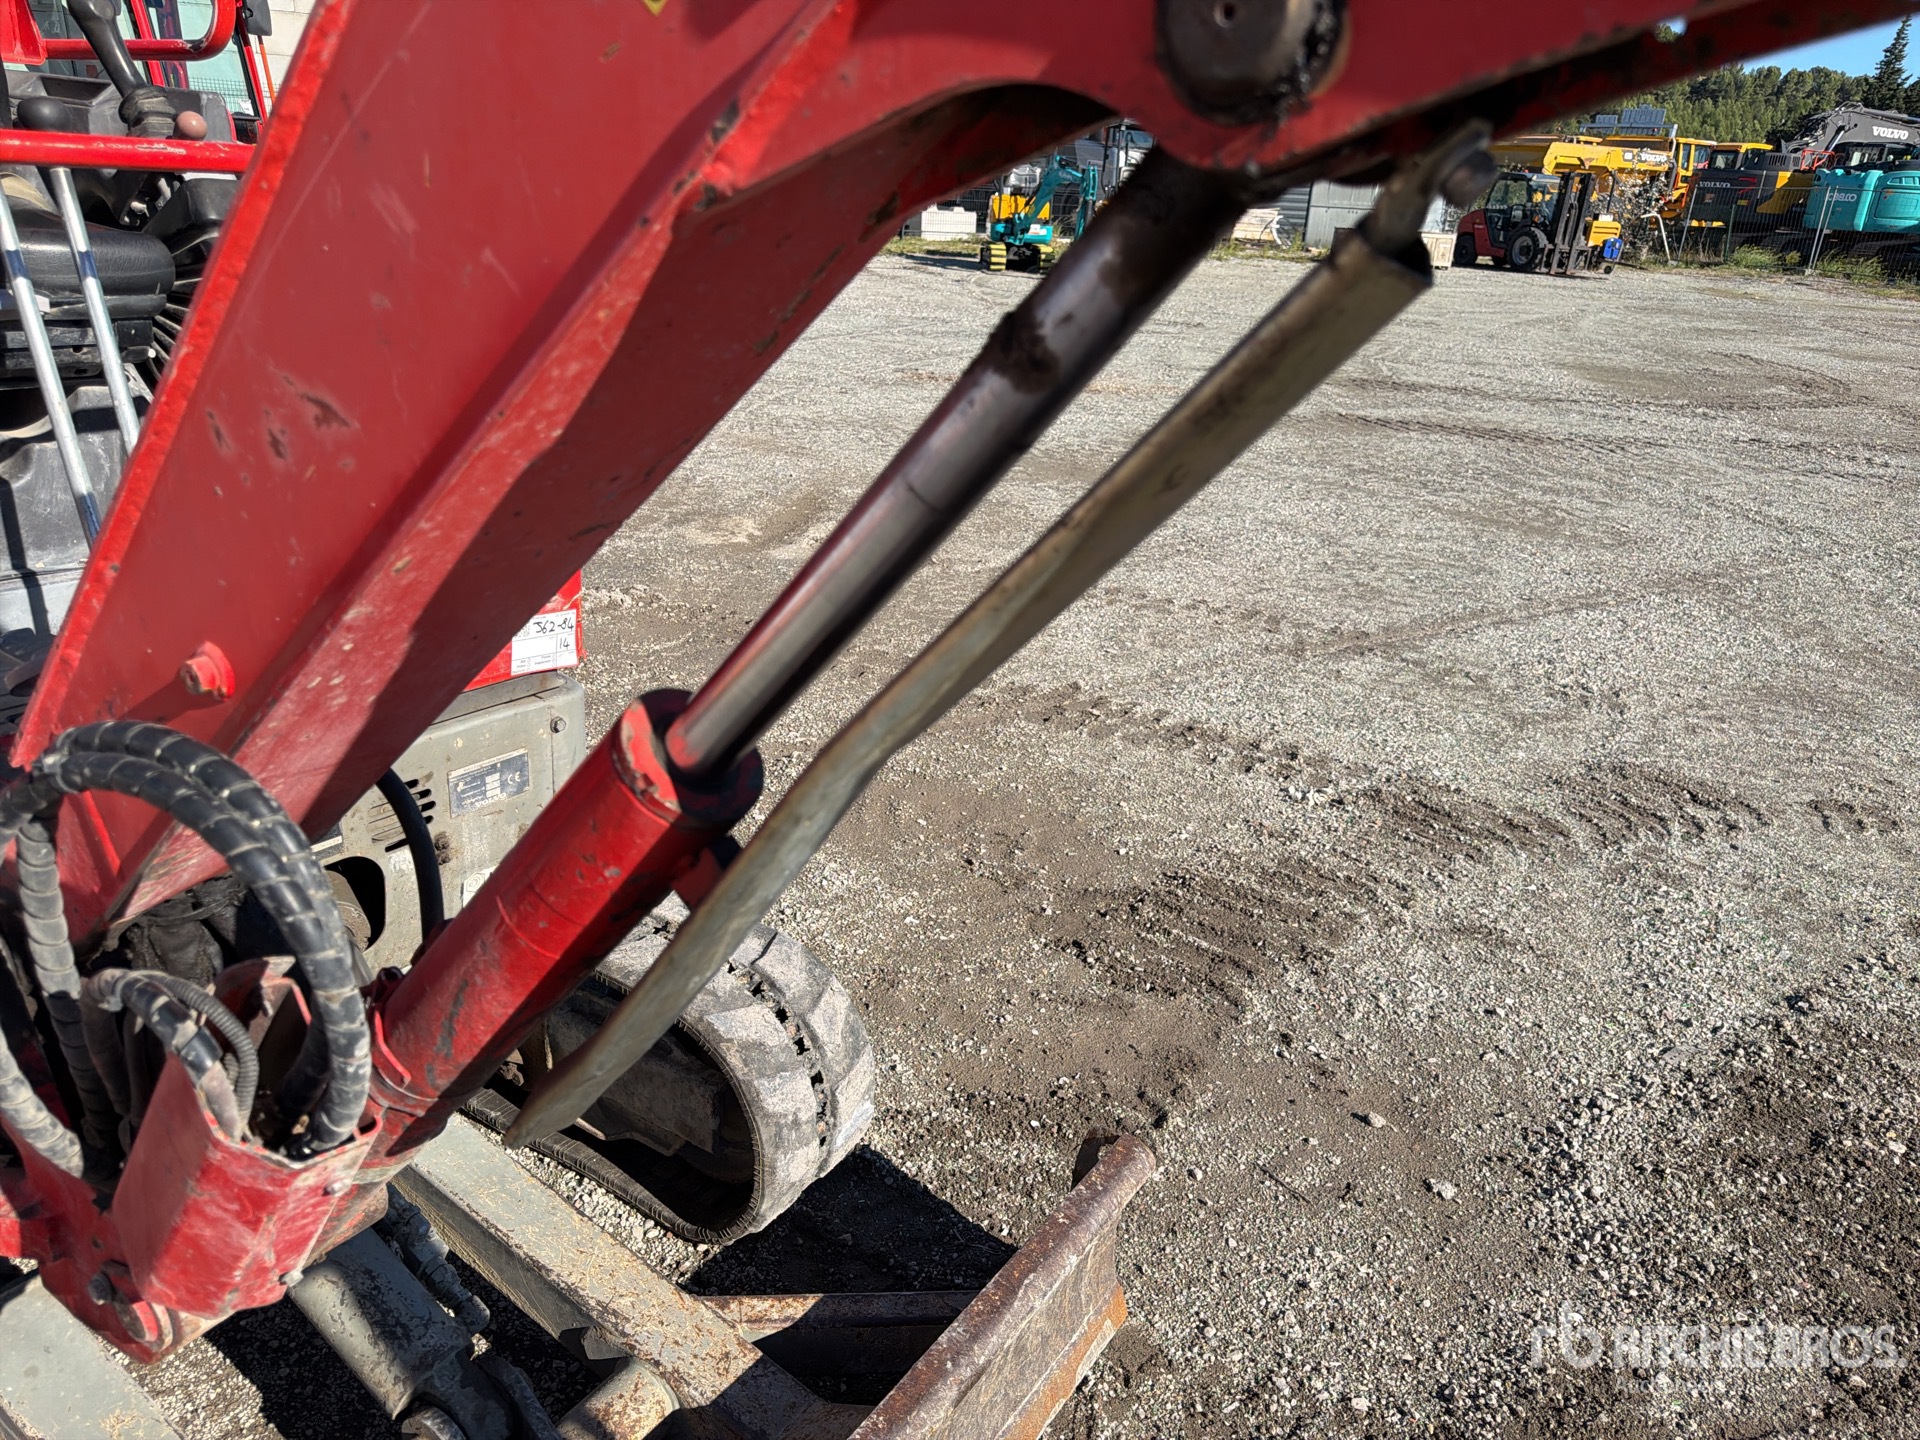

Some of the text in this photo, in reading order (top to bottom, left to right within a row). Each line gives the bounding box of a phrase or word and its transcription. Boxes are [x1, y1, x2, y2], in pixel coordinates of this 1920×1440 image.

[1872, 126, 1909, 140] VOLVO
[1640, 152, 1668, 162] VOLVO
[559, 637, 570, 651] 14
